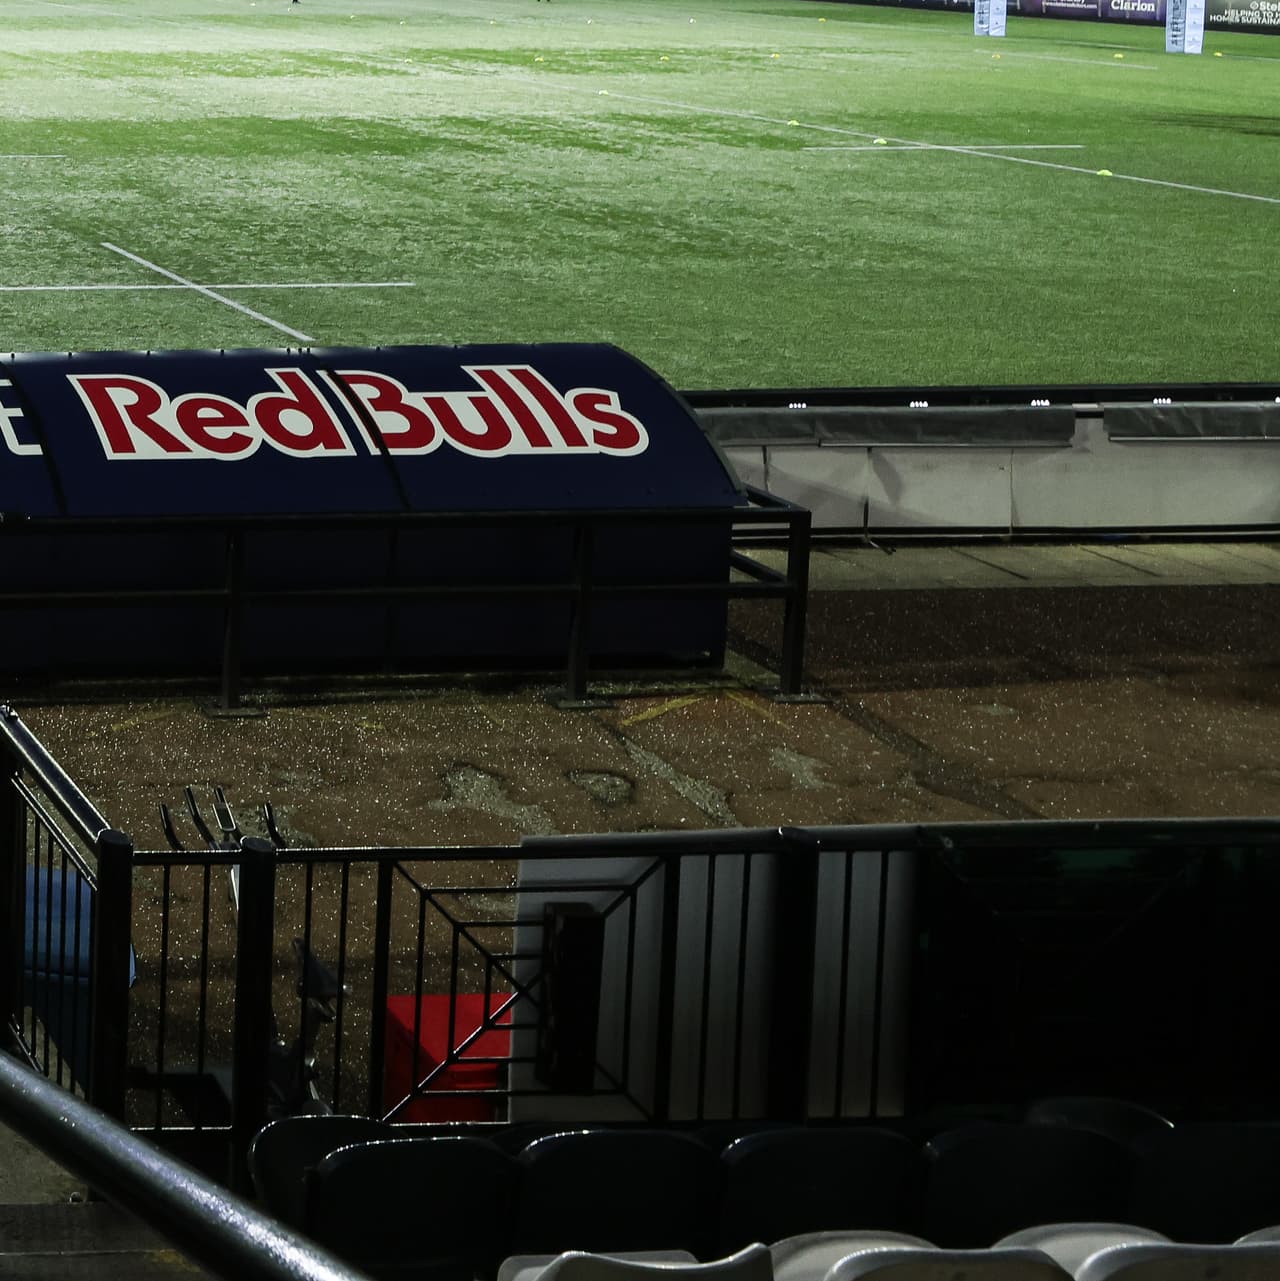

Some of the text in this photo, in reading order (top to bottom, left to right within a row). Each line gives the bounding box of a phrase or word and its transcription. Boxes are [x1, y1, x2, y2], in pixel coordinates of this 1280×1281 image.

[1224, 9, 1260, 17] HELPING
[1210, 14, 1240, 23] HOMES
[66, 368, 357, 461] Red
[320, 365, 648, 457] Bulls
